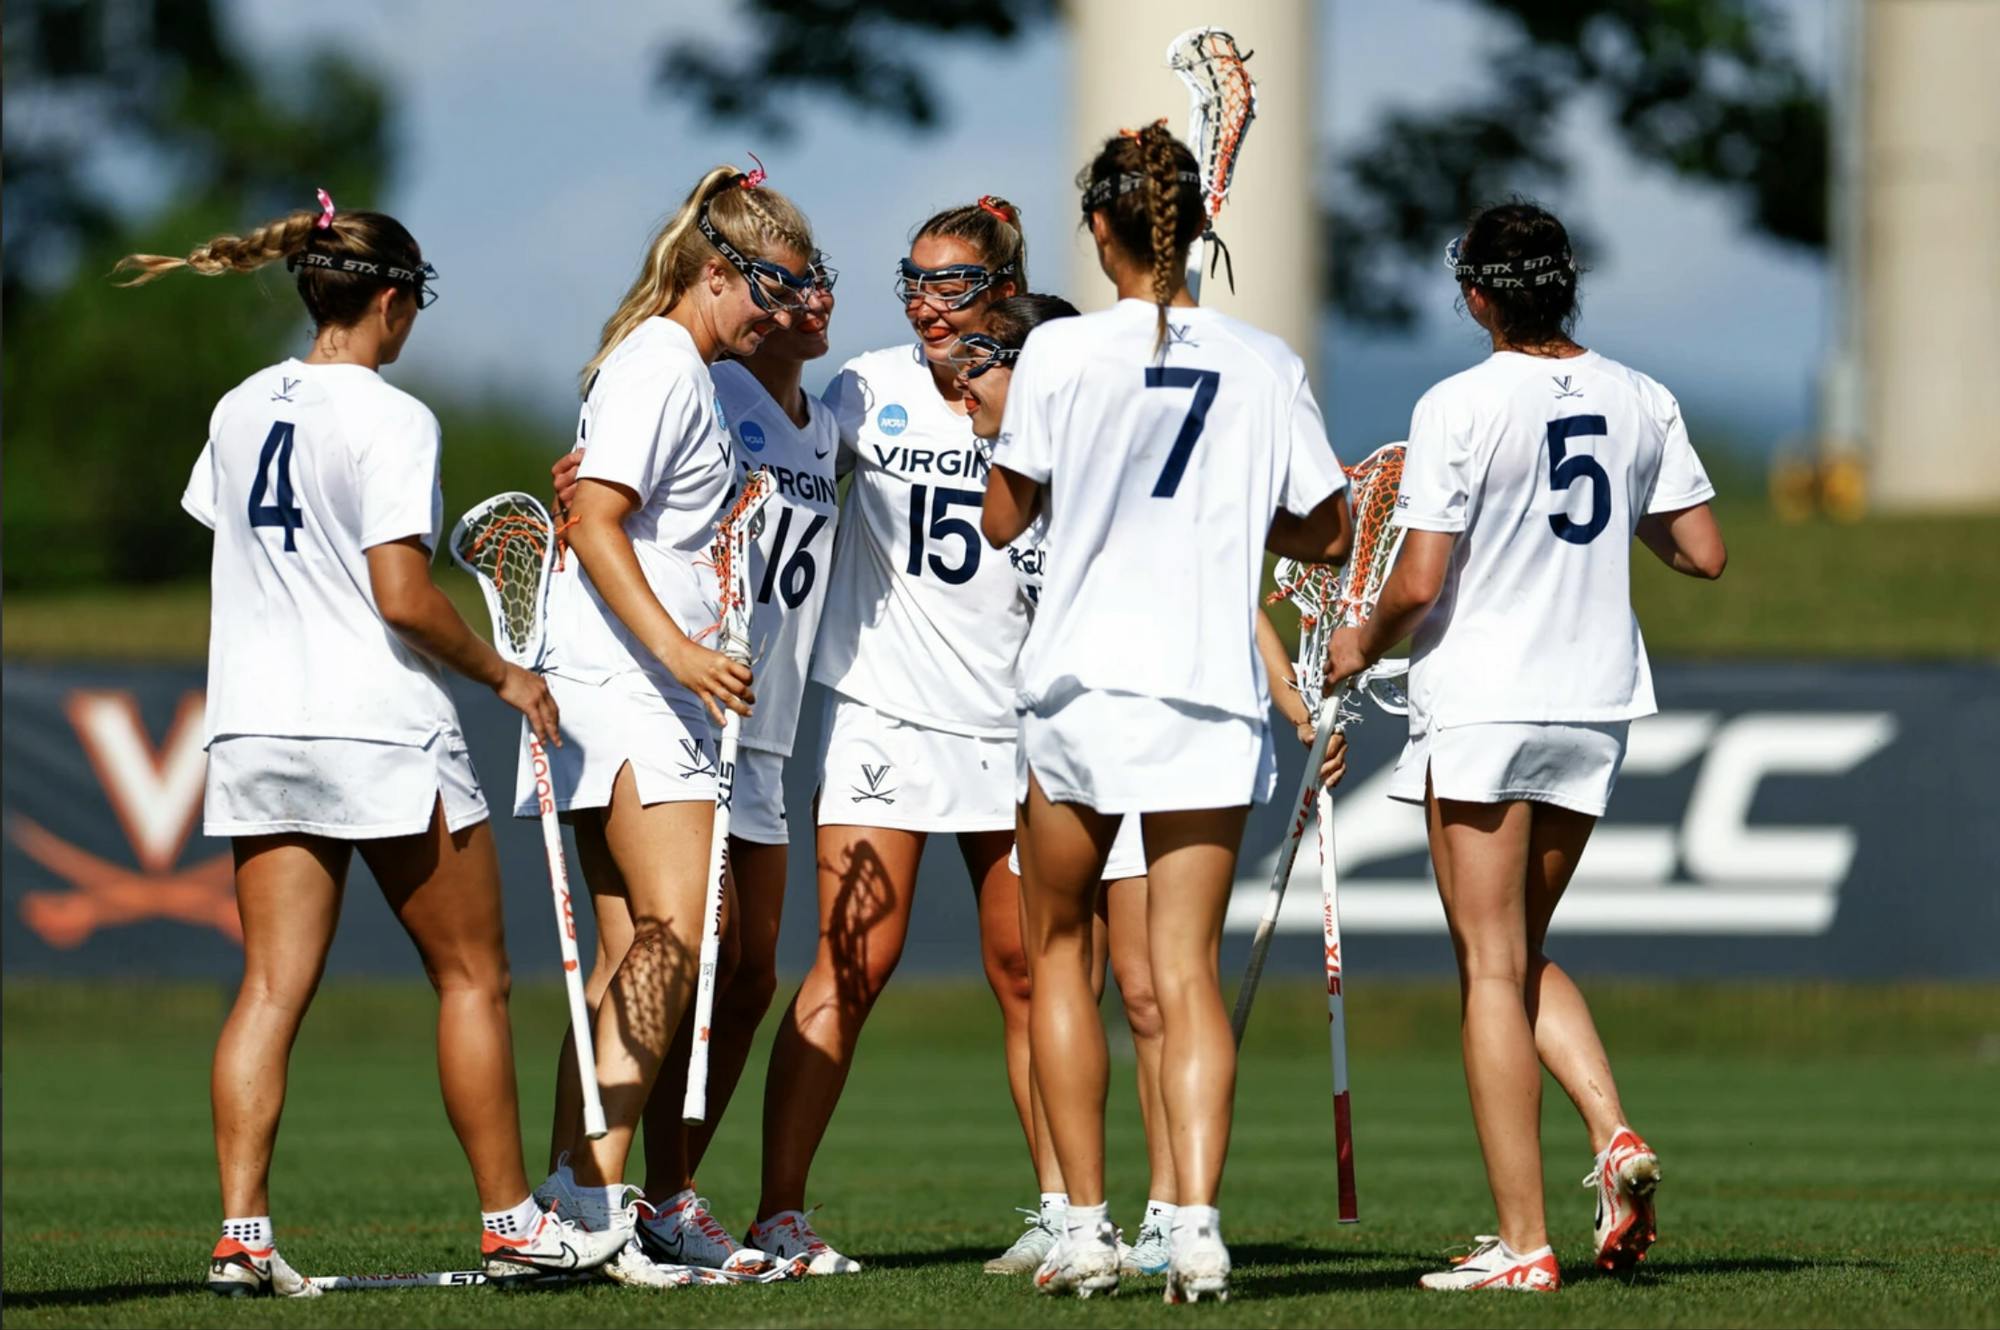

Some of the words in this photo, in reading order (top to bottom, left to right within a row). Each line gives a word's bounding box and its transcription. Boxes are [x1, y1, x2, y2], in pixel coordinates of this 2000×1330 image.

[306, 253, 333, 267] STX
[342, 259, 379, 275] STX
[387, 267, 416, 282] STX
[718, 242, 749, 271] STX
[1456, 264, 1476, 276] STX
[1482, 262, 1513, 275] STX
[1493, 277, 1525, 288] STX
[880, 417, 906, 429] NCAA
[1145, 366, 1221, 499] 7
[247, 420, 304, 552] 4
[1546, 414, 1612, 545] 5
[757, 506, 829, 610] 16
[907, 483, 986, 585] 15
[717, 760, 735, 813] STX
[1324, 942, 1341, 996] STX
